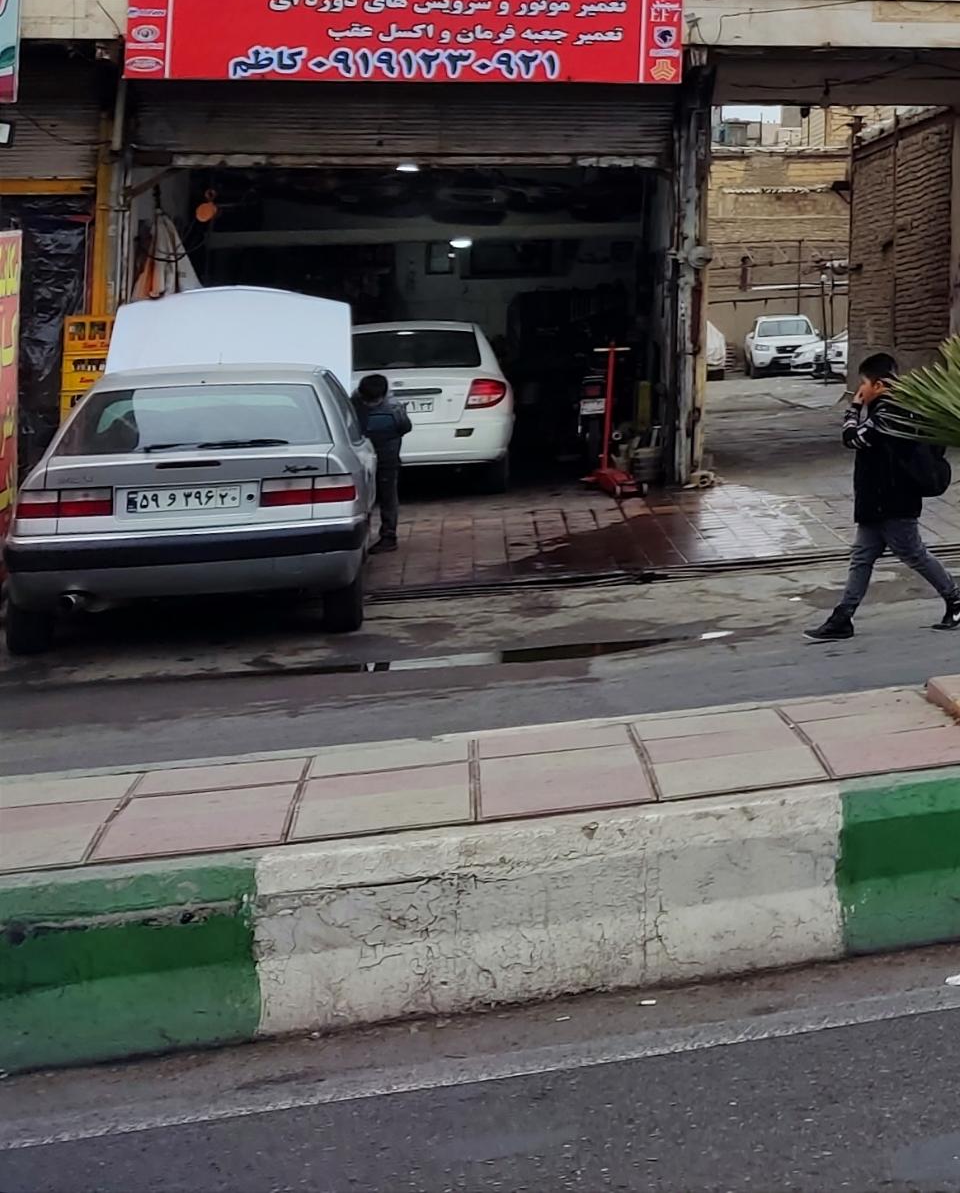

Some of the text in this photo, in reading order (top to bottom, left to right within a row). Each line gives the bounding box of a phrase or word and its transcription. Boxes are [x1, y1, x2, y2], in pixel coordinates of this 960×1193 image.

[496, 3, 510, 16] و
[650, 8, 682, 23] EF7
[327, 23, 374, 41] عقب
[438, 30, 451, 44] و
[455, 23, 517, 45] فرمان
[520, 29, 569, 45] جعبه
[571, 27, 624, 47] تعمیر
[229, 44, 307, 79] کاظم
[139, 492, 161, 510] ۵۹
[182, 490, 214, 506] ۳۹۶
[218, 492, 237, 504] ۲۰
